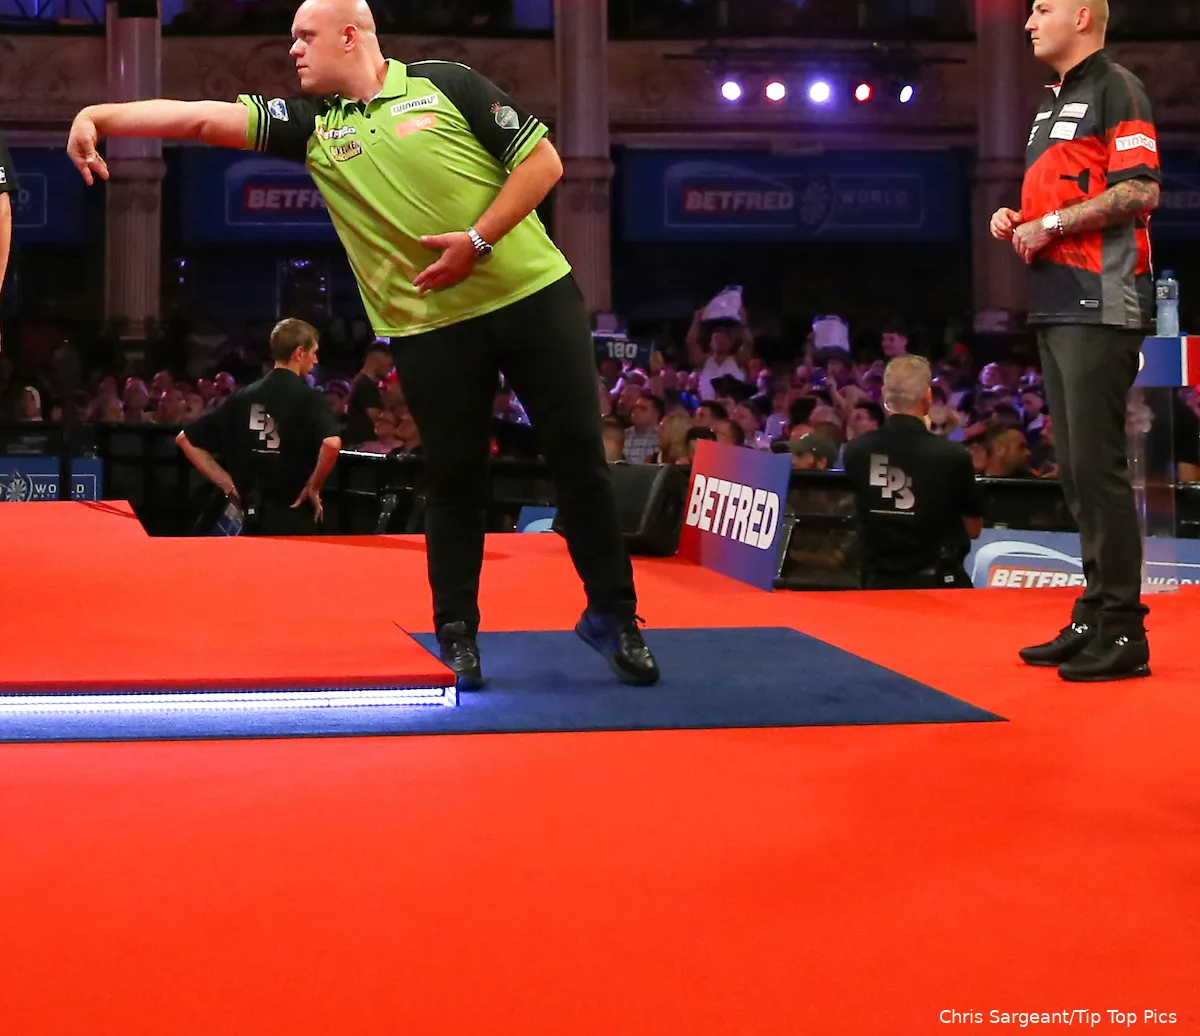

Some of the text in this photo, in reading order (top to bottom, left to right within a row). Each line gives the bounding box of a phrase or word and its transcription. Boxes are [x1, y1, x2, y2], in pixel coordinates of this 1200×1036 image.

[247, 189, 326, 209] BETFR
[685, 190, 795, 210] BETFRED
[606, 341, 638, 358] 180
[35, 484, 85, 494] WOD
[686, 474, 780, 550] BETFRED
[991, 569, 1088, 589] BETFRE
